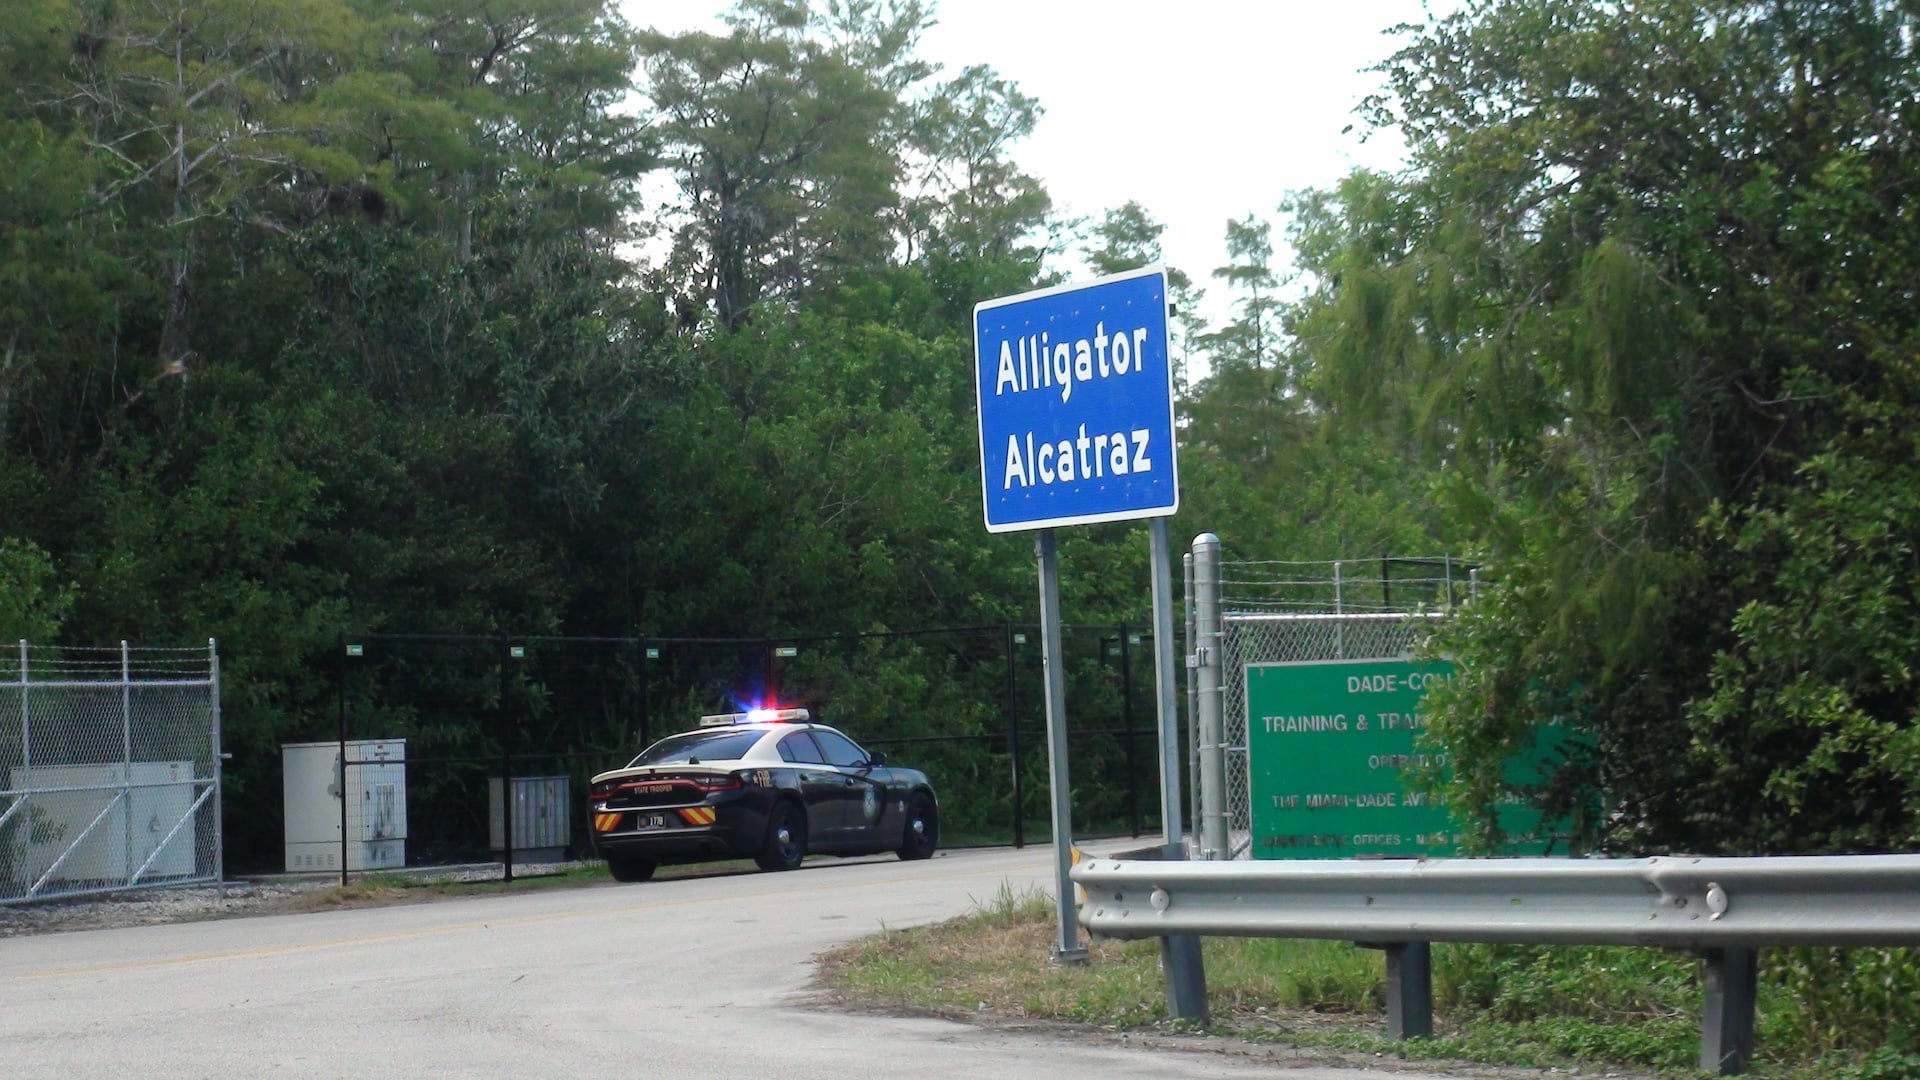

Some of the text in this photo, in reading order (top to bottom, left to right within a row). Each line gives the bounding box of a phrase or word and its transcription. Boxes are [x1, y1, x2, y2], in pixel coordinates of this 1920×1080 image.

[996, 321, 1147, 404] Alligator
[1004, 423, 1151, 489] Alcatraz
[1262, 714, 1348, 733] TRAINING
[1356, 714, 1368, 731] &
[634, 784, 673, 795] STATE TROOPER
[1306, 792, 1397, 808] MIAMI-DADE
[1353, 834, 1401, 846] OFFICES
